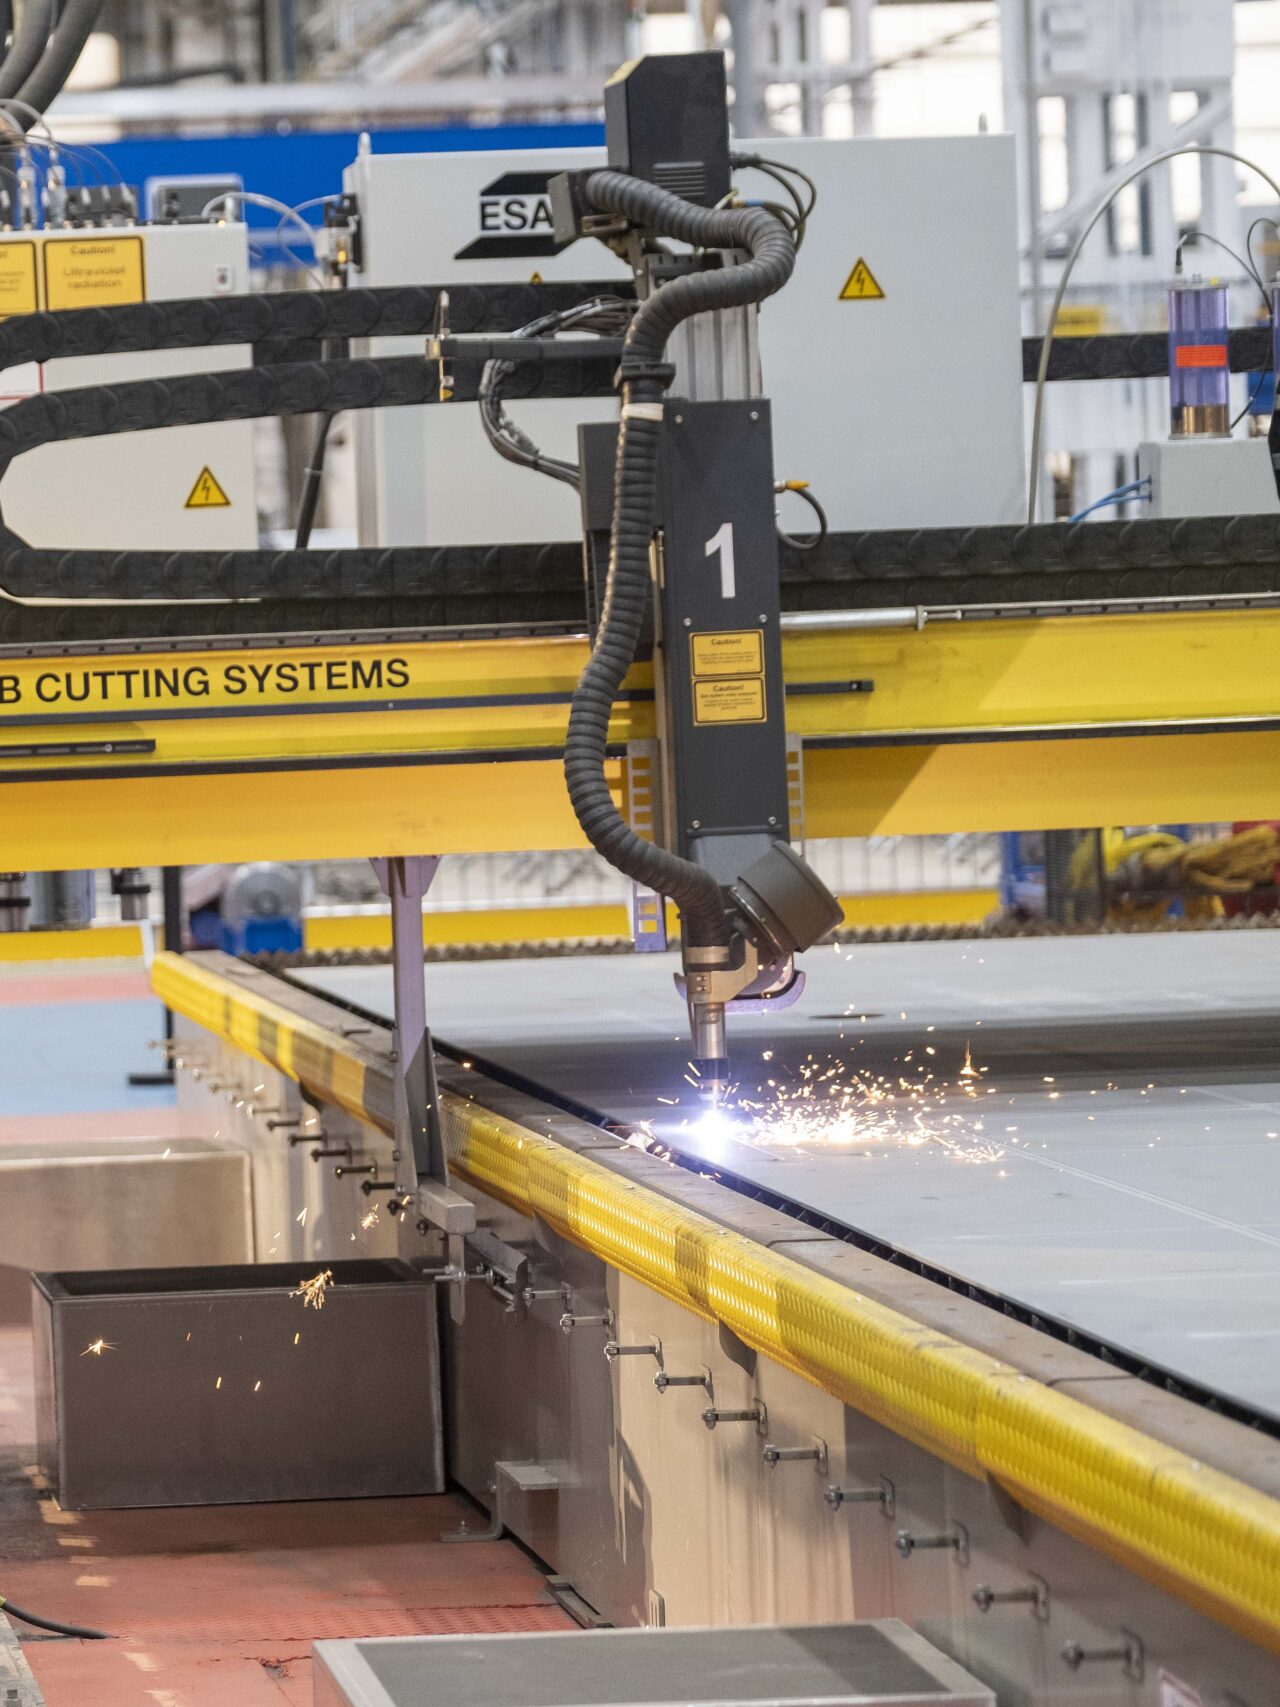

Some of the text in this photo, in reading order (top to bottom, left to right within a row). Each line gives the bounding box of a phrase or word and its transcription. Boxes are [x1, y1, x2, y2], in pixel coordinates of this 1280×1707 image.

[480, 198, 554, 231] ESA
[705, 522, 736, 599] 1
[35, 666, 210, 703] CUTTING
[223, 658, 410, 694] SYSTEMS
